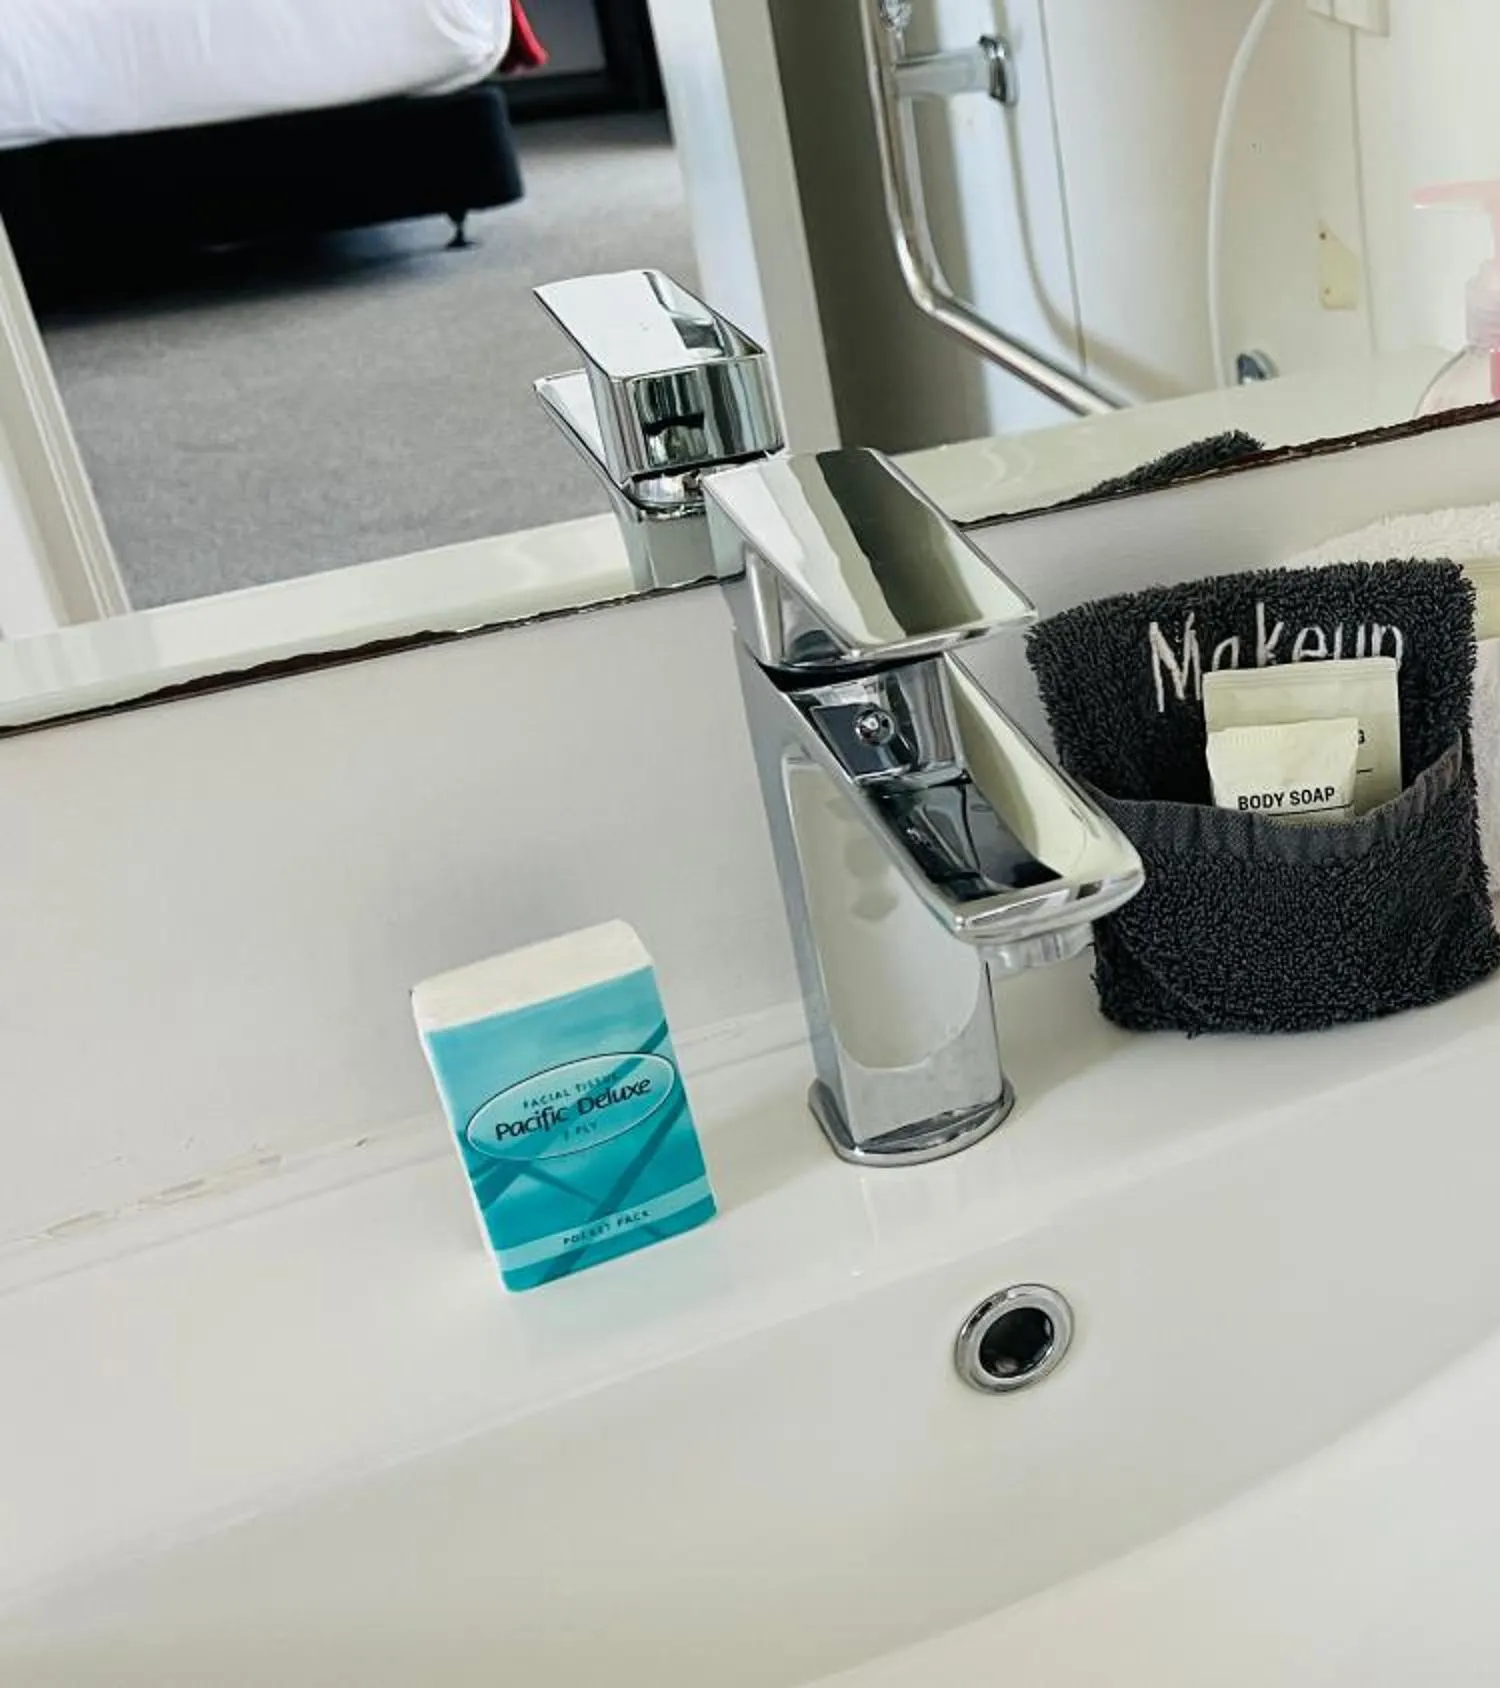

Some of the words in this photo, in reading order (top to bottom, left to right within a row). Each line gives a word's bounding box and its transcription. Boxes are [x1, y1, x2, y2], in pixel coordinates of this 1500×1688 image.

[1238, 791, 1285, 811] BODY
[1289, 786, 1335, 806] SOAP
[494, 1105, 569, 1141] Pacific
[577, 1078, 652, 1115] Deluxe
[523, 1088, 571, 1109] FACIAL
